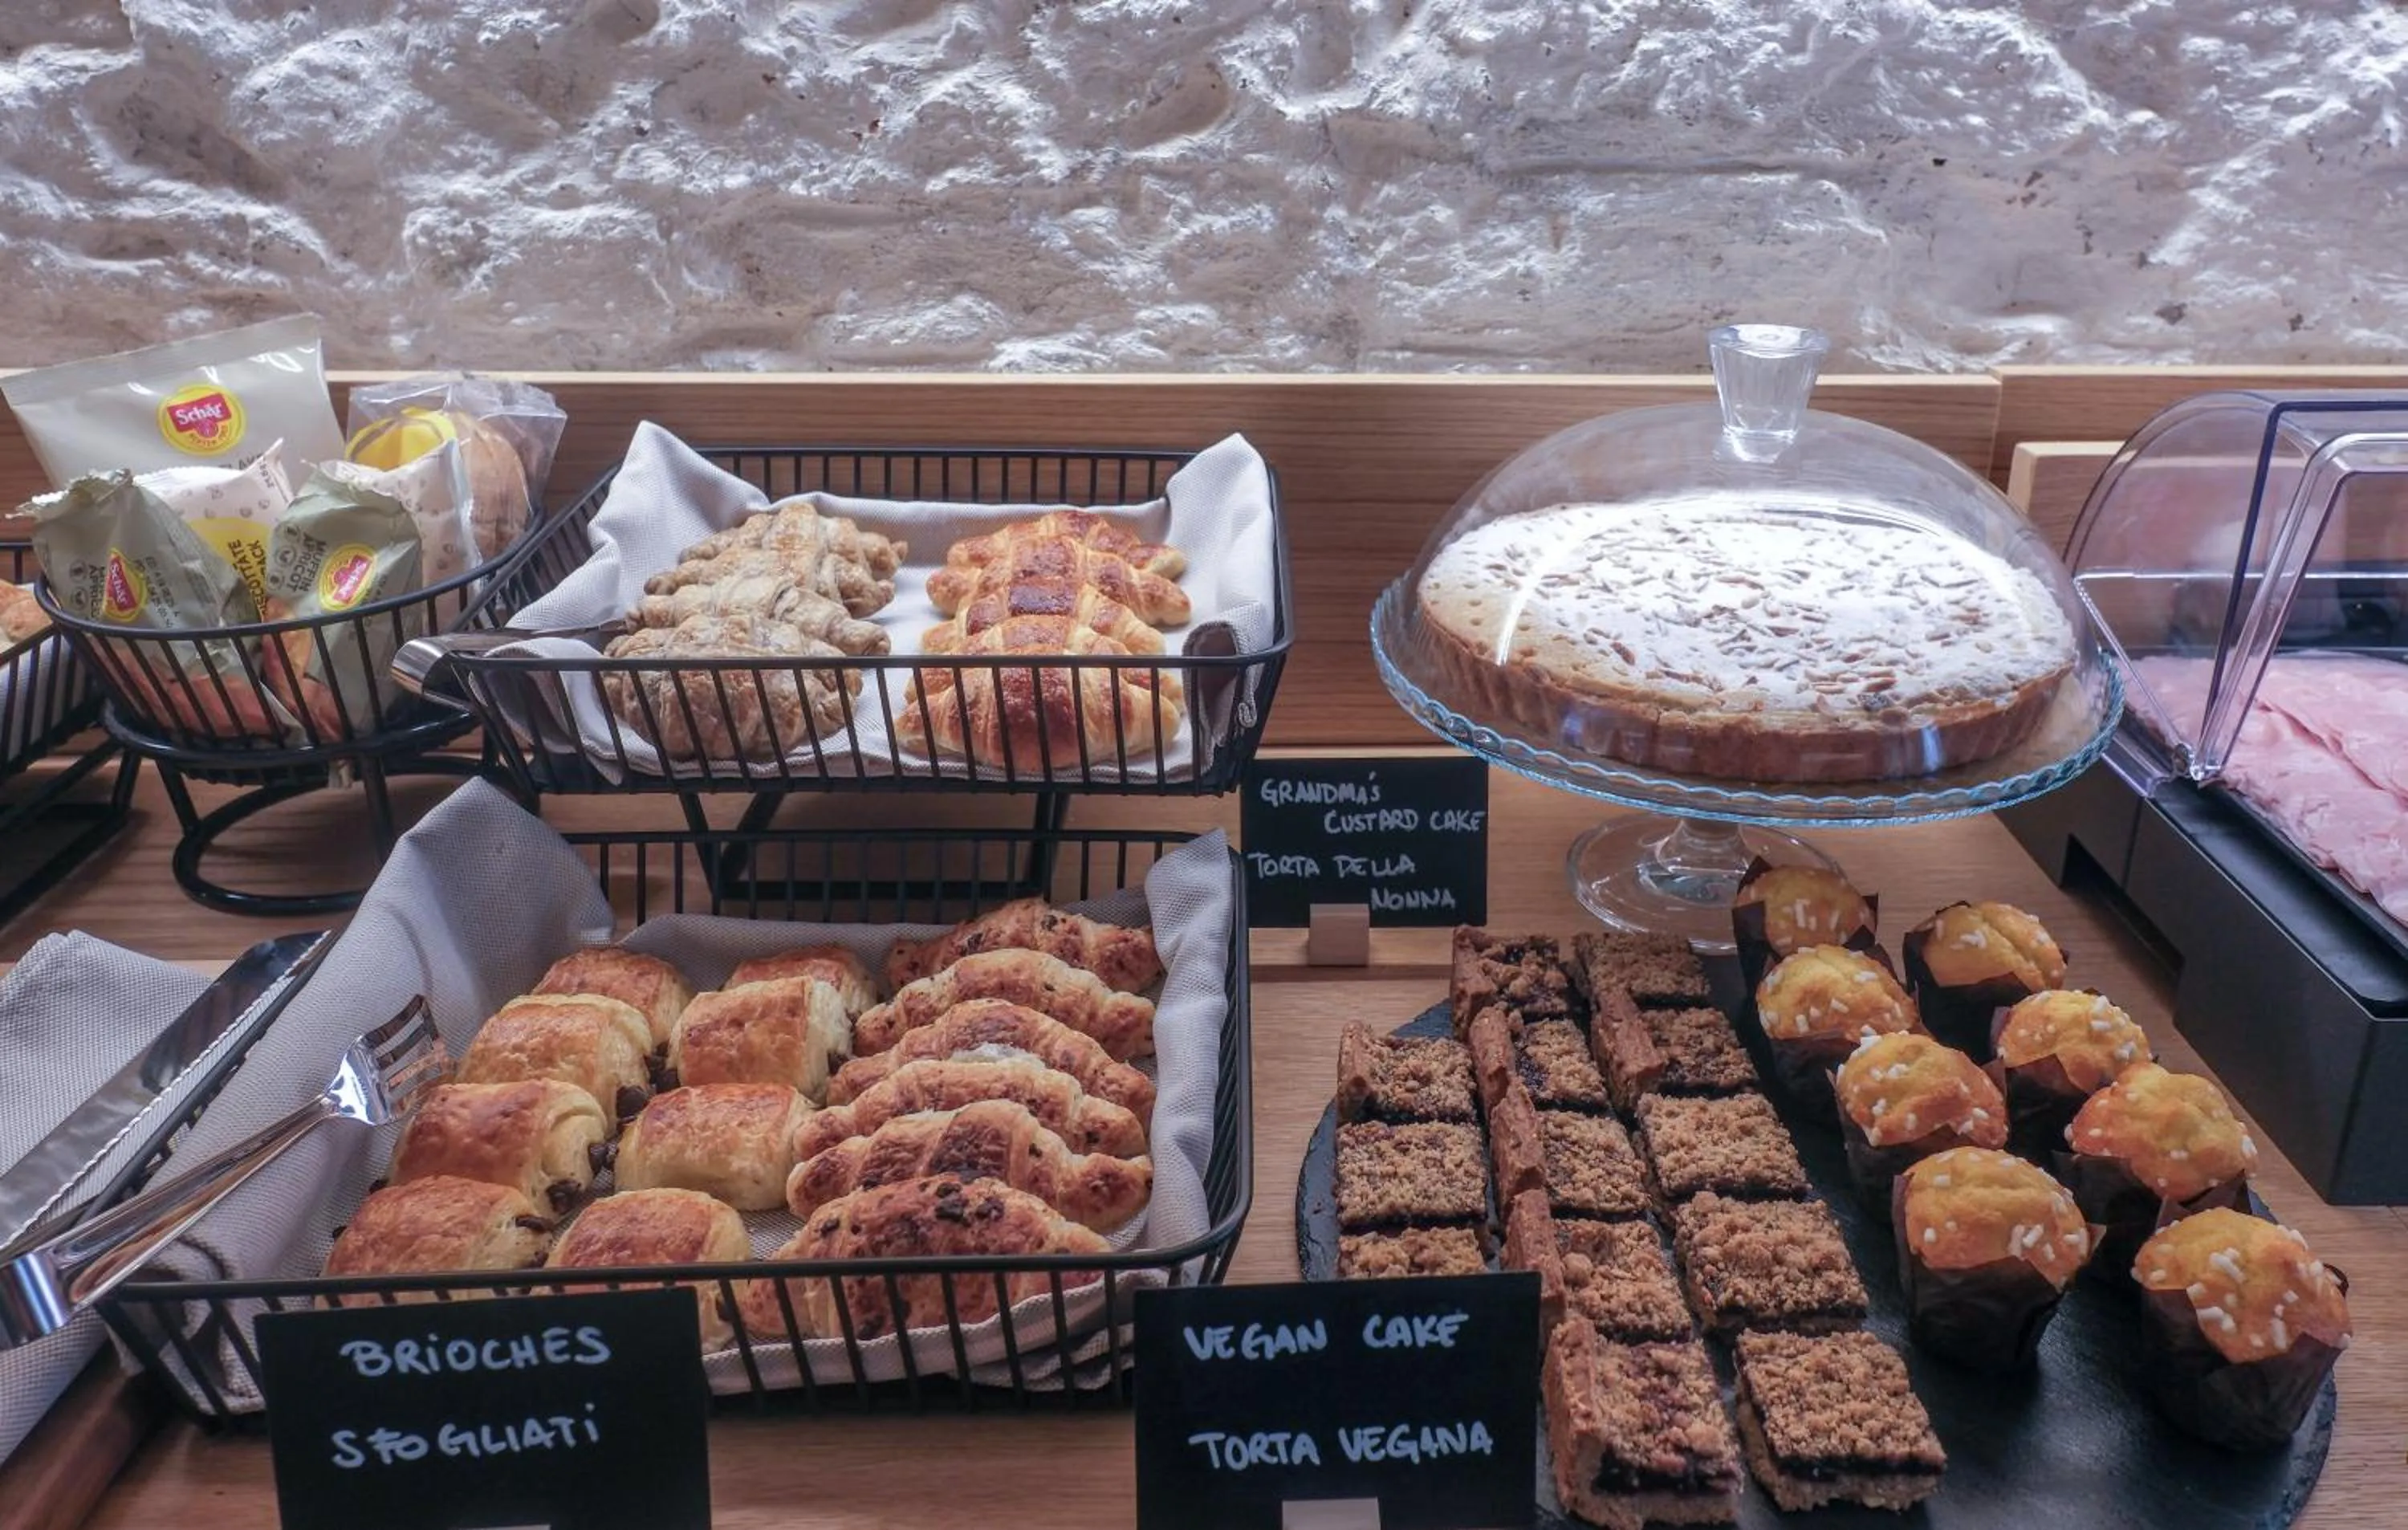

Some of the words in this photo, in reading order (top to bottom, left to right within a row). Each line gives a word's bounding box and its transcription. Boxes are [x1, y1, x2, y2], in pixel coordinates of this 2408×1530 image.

[175, 401, 222, 425] Schär
[287, 532, 315, 592] APRICOT
[299, 540, 327, 592] MUFFIN
[1324, 808, 1418, 834] CUSTARD
[1430, 810, 1486, 832] CAKE
[1247, 852, 1320, 879] TORTA
[1332, 853, 1417, 878] DELLA
[1370, 887, 1456, 912] NONNA
[1182, 1318, 1328, 1361] VEGAN
[1363, 1309, 1470, 1349] CAKE
[1188, 1430, 1321, 1471] TORTA
[1338, 1420, 1494, 1465] VEGANA
